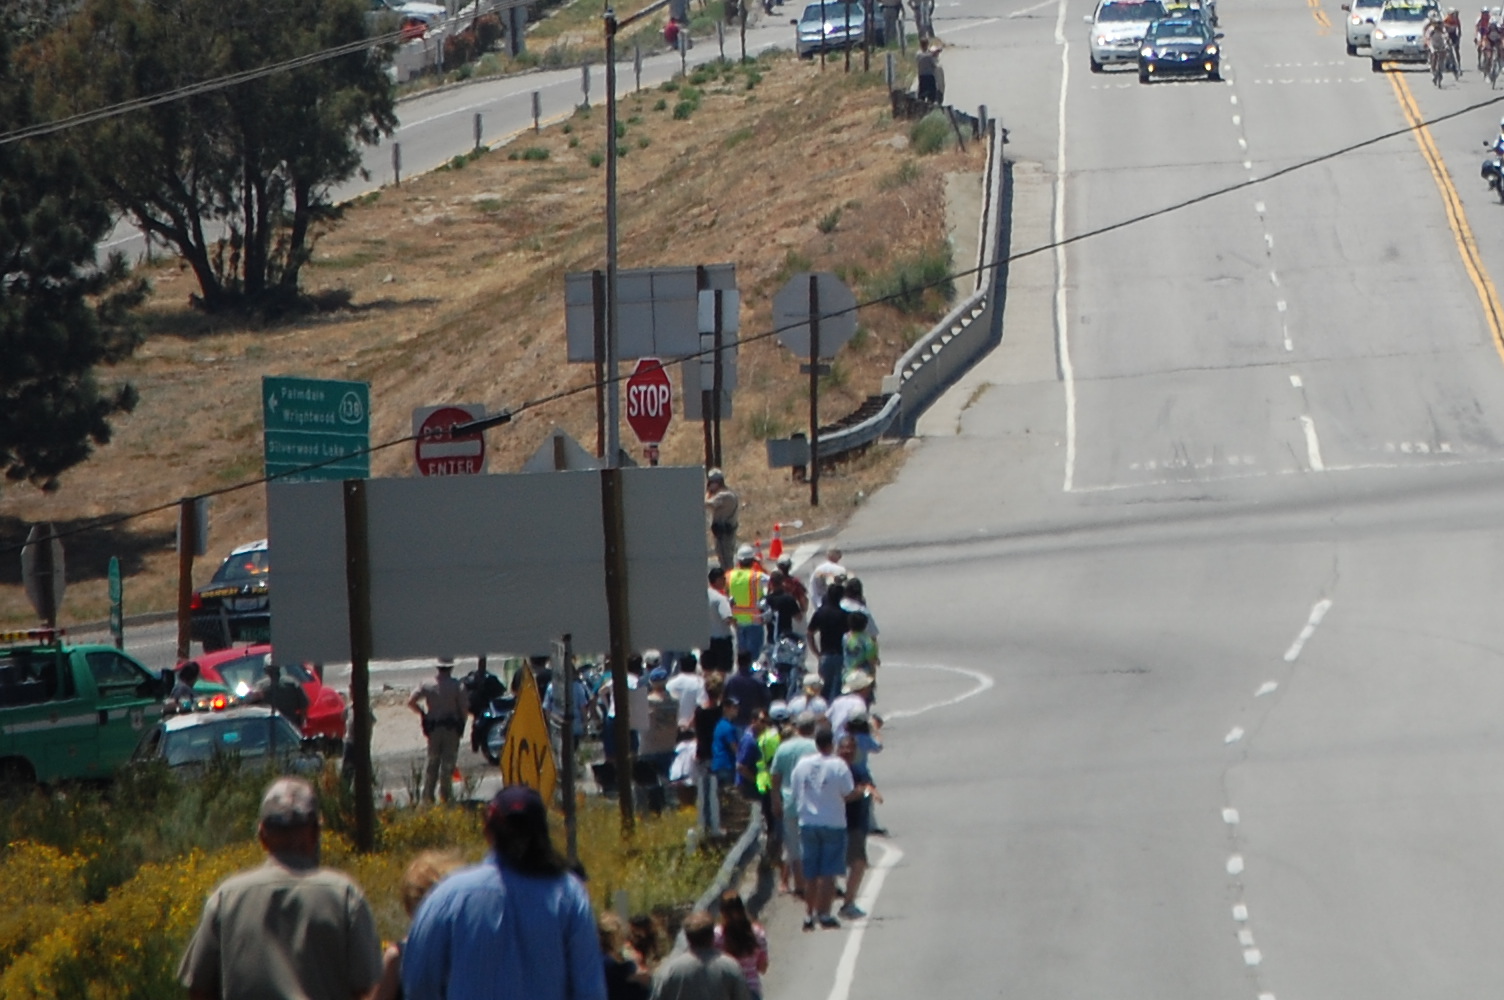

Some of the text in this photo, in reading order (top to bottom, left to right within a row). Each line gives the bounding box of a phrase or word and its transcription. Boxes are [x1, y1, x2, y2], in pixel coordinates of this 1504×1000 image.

[281, 386, 325, 401] Palmdale
[629, 384, 670, 417] STOP
[283, 409, 336, 425] Wrightwood
[343, 400, 360, 418] 138
[268, 441, 345, 457] Silverwood Lake
[427, 460, 475, 476] ENTER
[509, 736, 547, 788] ICY
